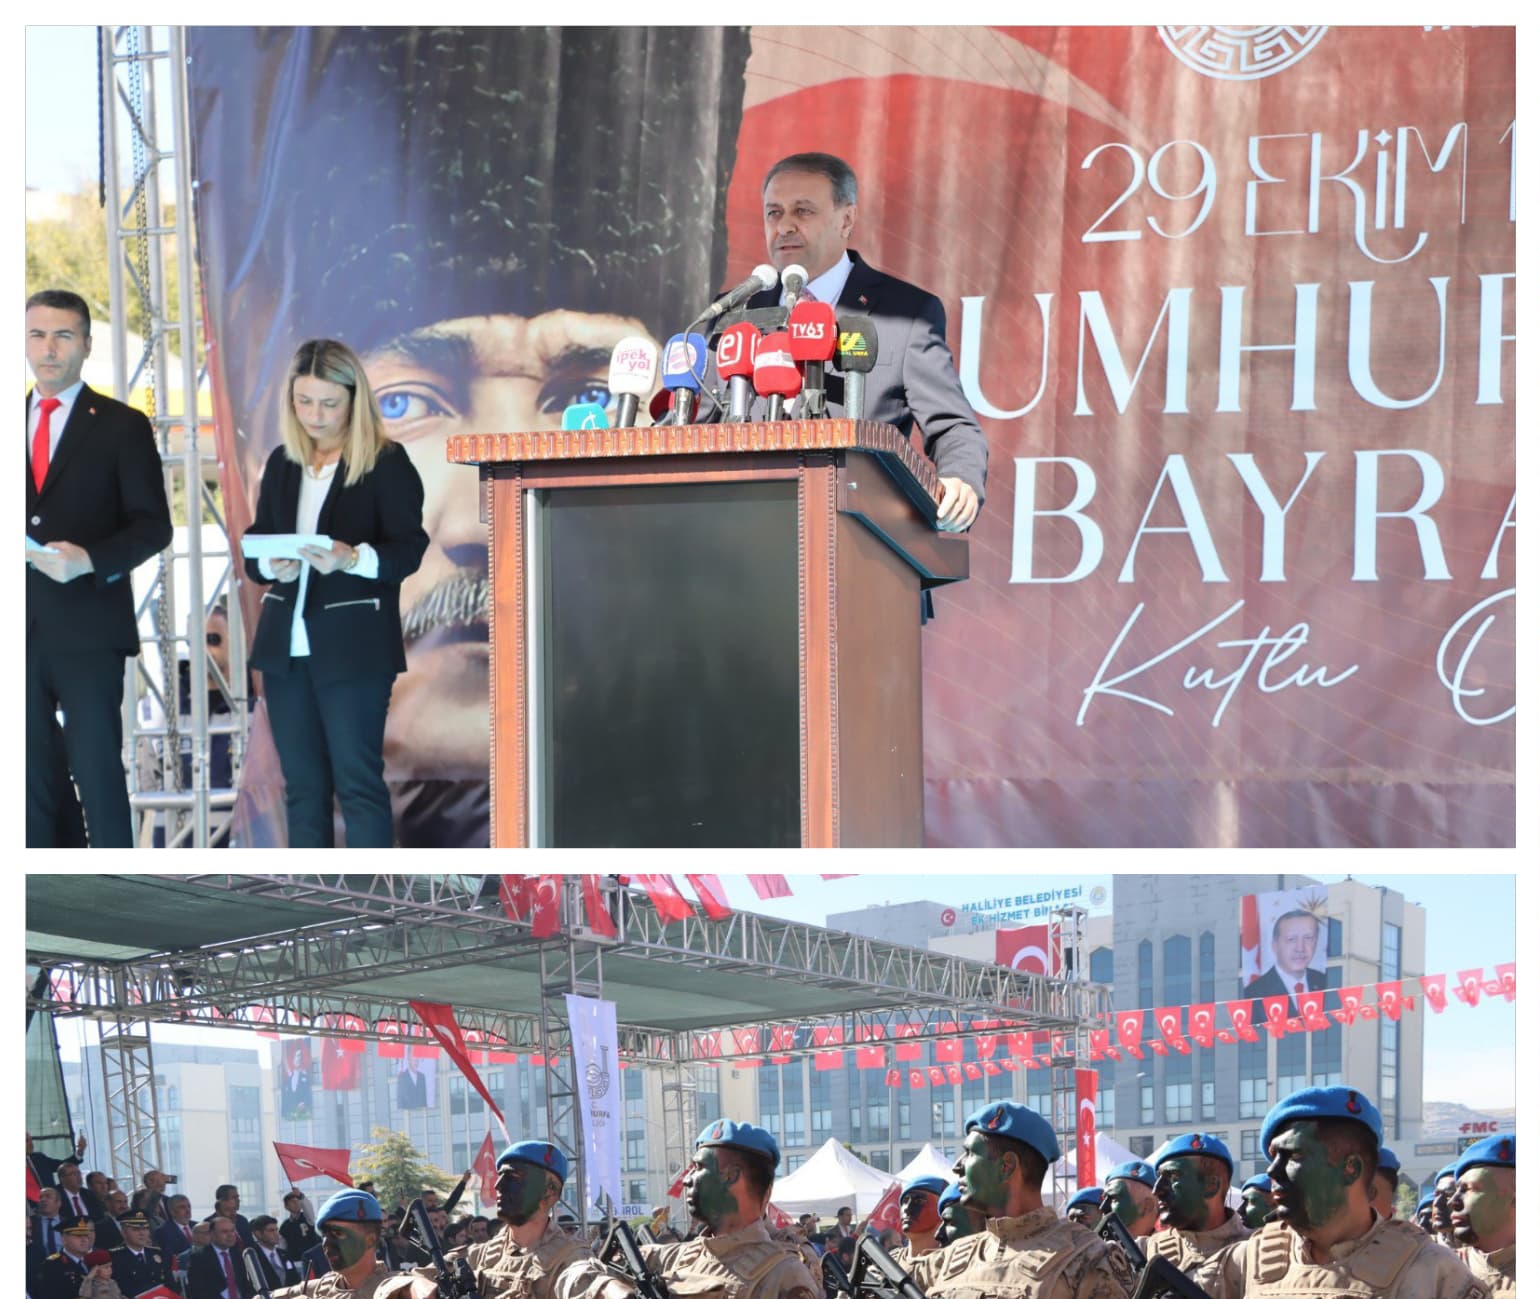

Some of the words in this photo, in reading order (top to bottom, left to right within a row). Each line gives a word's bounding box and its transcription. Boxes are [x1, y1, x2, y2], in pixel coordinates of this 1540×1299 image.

[1081, 140, 1217, 244] 29
[1245, 122, 1468, 263] EKİM
[959, 272, 1516, 421] UMHU
[1075, 599, 1359, 727] Kutlu
[961, 897, 1012, 913] HALİLİYE
[1015, 885, 1083, 906] BELEDİYESİ
[989, 908, 1031, 923] HİZMET
